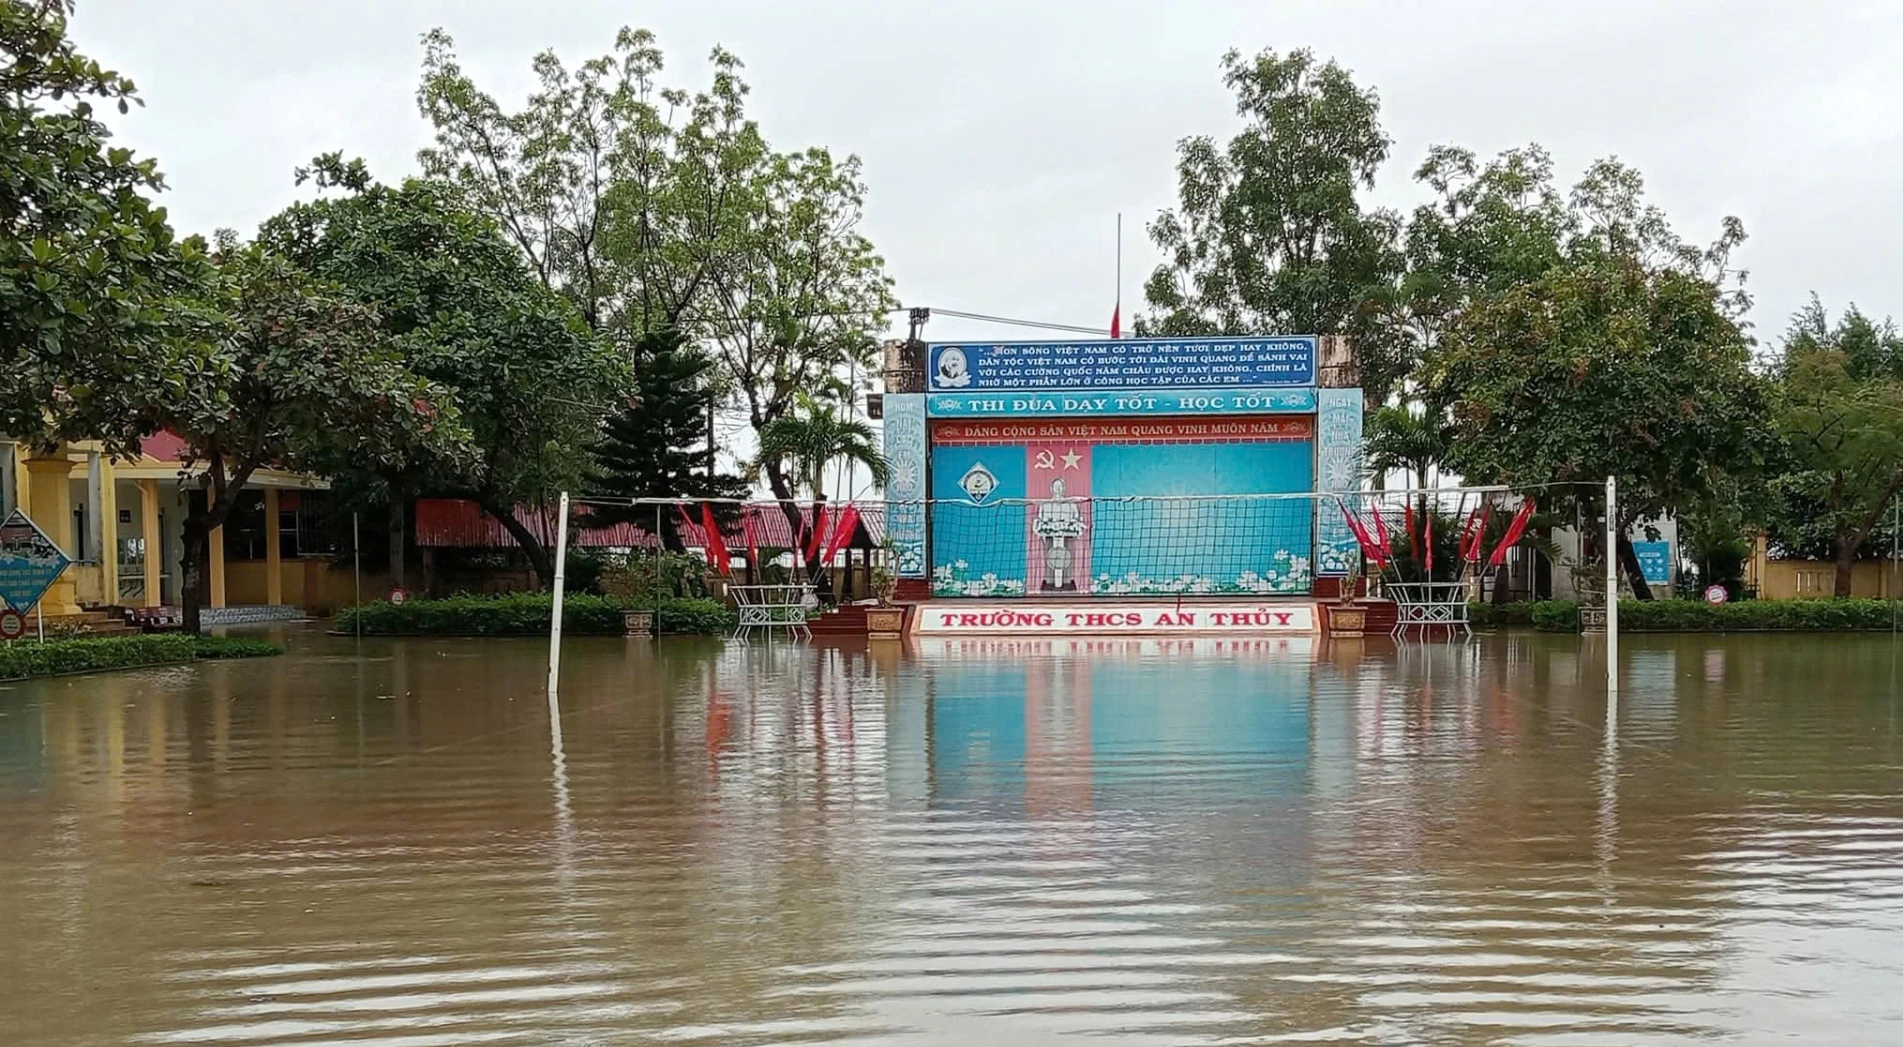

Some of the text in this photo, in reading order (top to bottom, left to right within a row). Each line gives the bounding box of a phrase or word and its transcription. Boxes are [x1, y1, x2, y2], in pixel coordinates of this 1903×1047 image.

[1022, 347, 1050, 355] SÔNG
[1055, 346, 1080, 356] VIỆT
[1084, 346, 1108, 354] NAM
[1112, 344, 1127, 354] CÓ
[1158, 344, 1180, 353] NÊN
[1184, 344, 1210, 352] TƯƠI
[1240, 344, 1262, 352] HAY
[978, 358, 1000, 366] DÂN
[1003, 358, 1025, 367] TỘC
[1027, 357, 1052, 366] VIỆT
[1055, 357, 1077, 365] NAM
[1080, 356, 1095, 365] CÓ
[1098, 356, 1126, 364] BƯỚC
[1200, 355, 1237, 363] QUANG
[1258, 352, 1286, 361] SÁNH
[1289, 353, 1307, 361] VAI
[978, 367, 997, 376] VỚI
[999, 367, 1022, 376] CÁC
[1024, 367, 1060, 376] CƯỜNG
[1063, 366, 1092, 377] QUỐC
[1095, 366, 1119, 375] NĂM
[1122, 365, 1151, 374] CHÂU
[1187, 365, 1210, 373] HAY
[1255, 363, 1290, 372] CHÍNH
[1293, 362, 1307, 371] LÀ
[978, 378, 1001, 387] NHỜ
[1003, 378, 1027, 387] MỘT
[1029, 376, 1057, 386] PHẦN
[1060, 377, 1081, 386] LỚN
[1094, 376, 1123, 385] CÔNG
[1125, 377, 1149, 386] HỌC
[1151, 376, 1172, 385] TẬP
[1174, 375, 1196, 384] CỦA
[1199, 374, 1221, 383] CÁC
[1223, 375, 1240, 383] EM
[967, 399, 1006, 412] THI
[1012, 399, 1057, 411] ĐUA
[1064, 398, 1107, 413] DẠY
[1114, 393, 1157, 410] TỐT
[1178, 397, 1225, 411] HỌC
[1231, 392, 1276, 408] TỐT
[964, 422, 1279, 437] ĐẢNG CỘNG SẢN VIỆT NAM QUANG VINH MUÔN NĂM
[940, 607, 1294, 627] TRƯỜNG THCS AN THỦY
